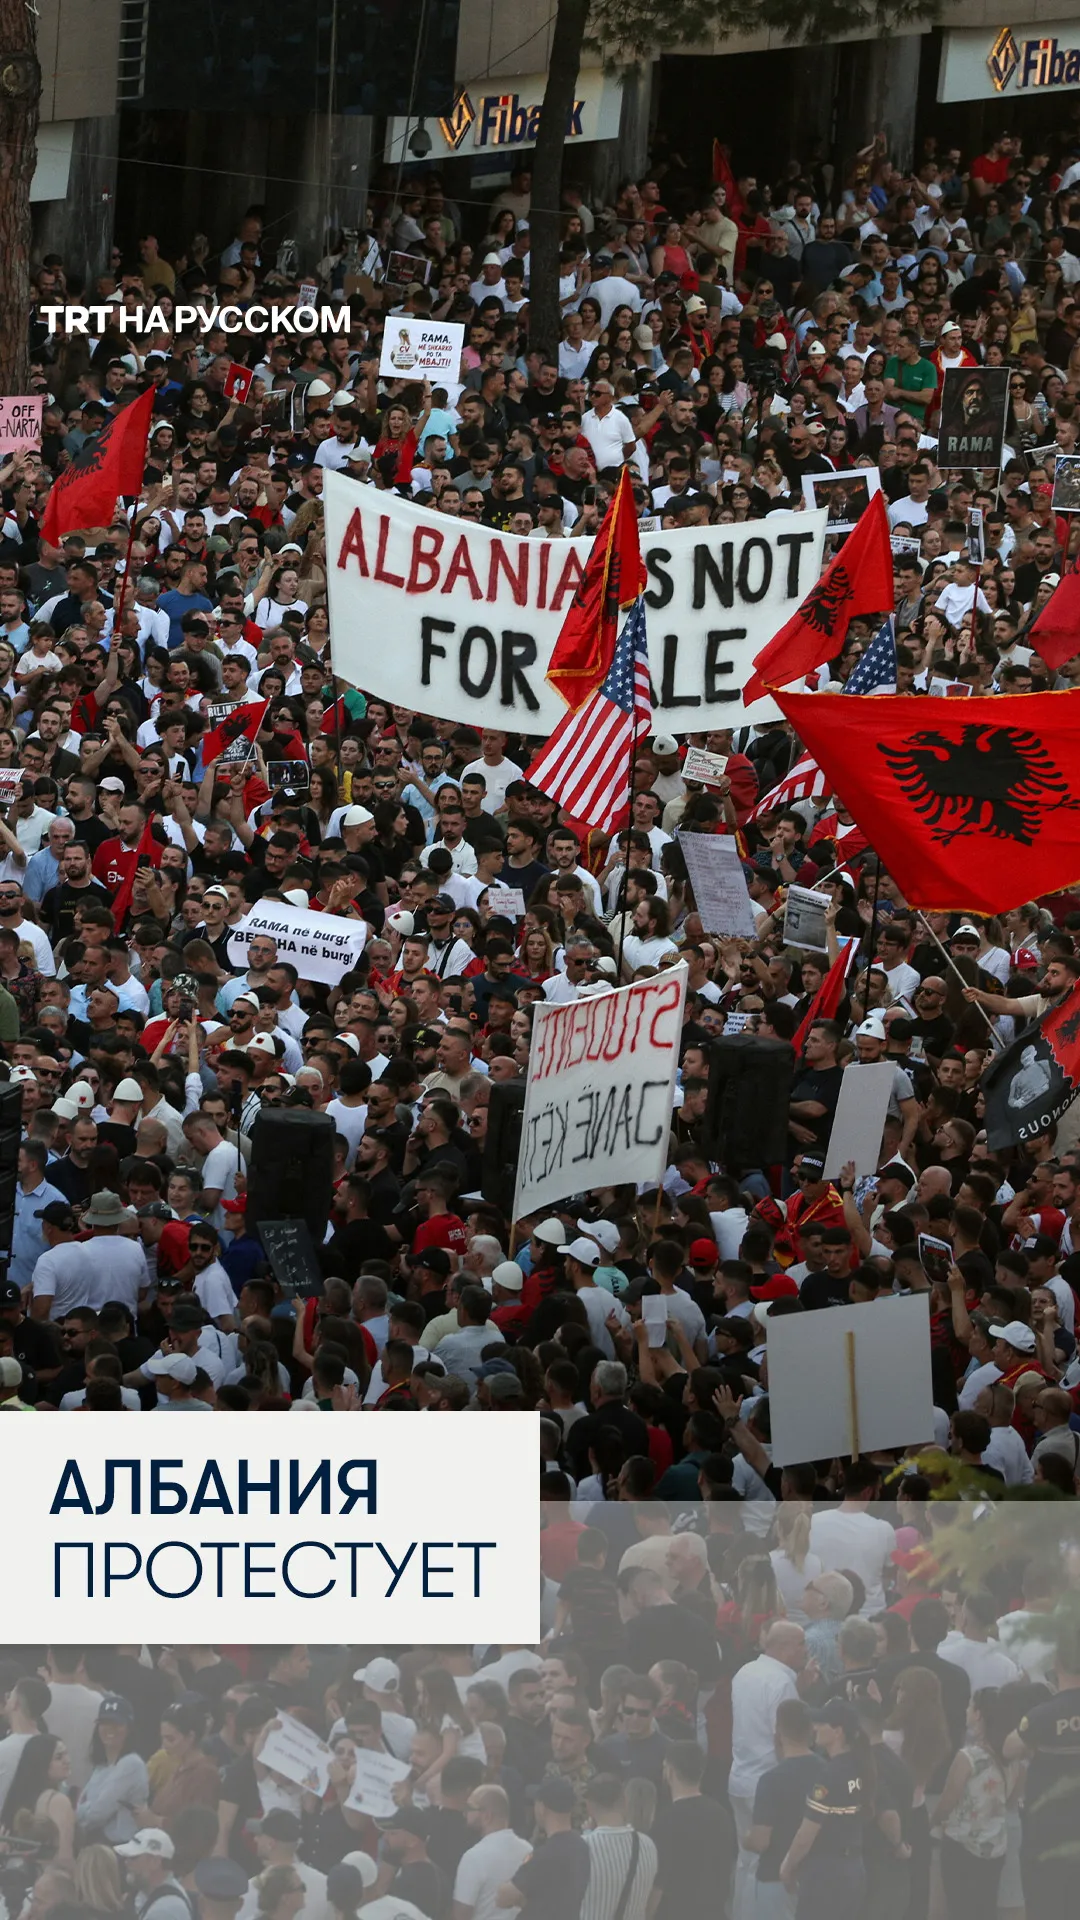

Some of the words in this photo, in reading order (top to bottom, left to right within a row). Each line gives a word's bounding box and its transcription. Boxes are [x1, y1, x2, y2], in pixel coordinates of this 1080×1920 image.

[475, 94, 585, 146] Fibak
[12, 405, 35, 418] OFF
[948, 436, 993, 452] RAMA
[337, 507, 584, 611] ALBANIA
[692, 532, 814, 609] NOT
[421, 616, 540, 711] FOR
[650, 628, 747, 710] LE
[234, 931, 297, 953] BEHA
[301, 945, 318, 956] në
[322, 947, 354, 965] burg!
[248, 918, 289, 933] RAMA
[292, 927, 310, 937] në
[313, 930, 351, 946] burg!
